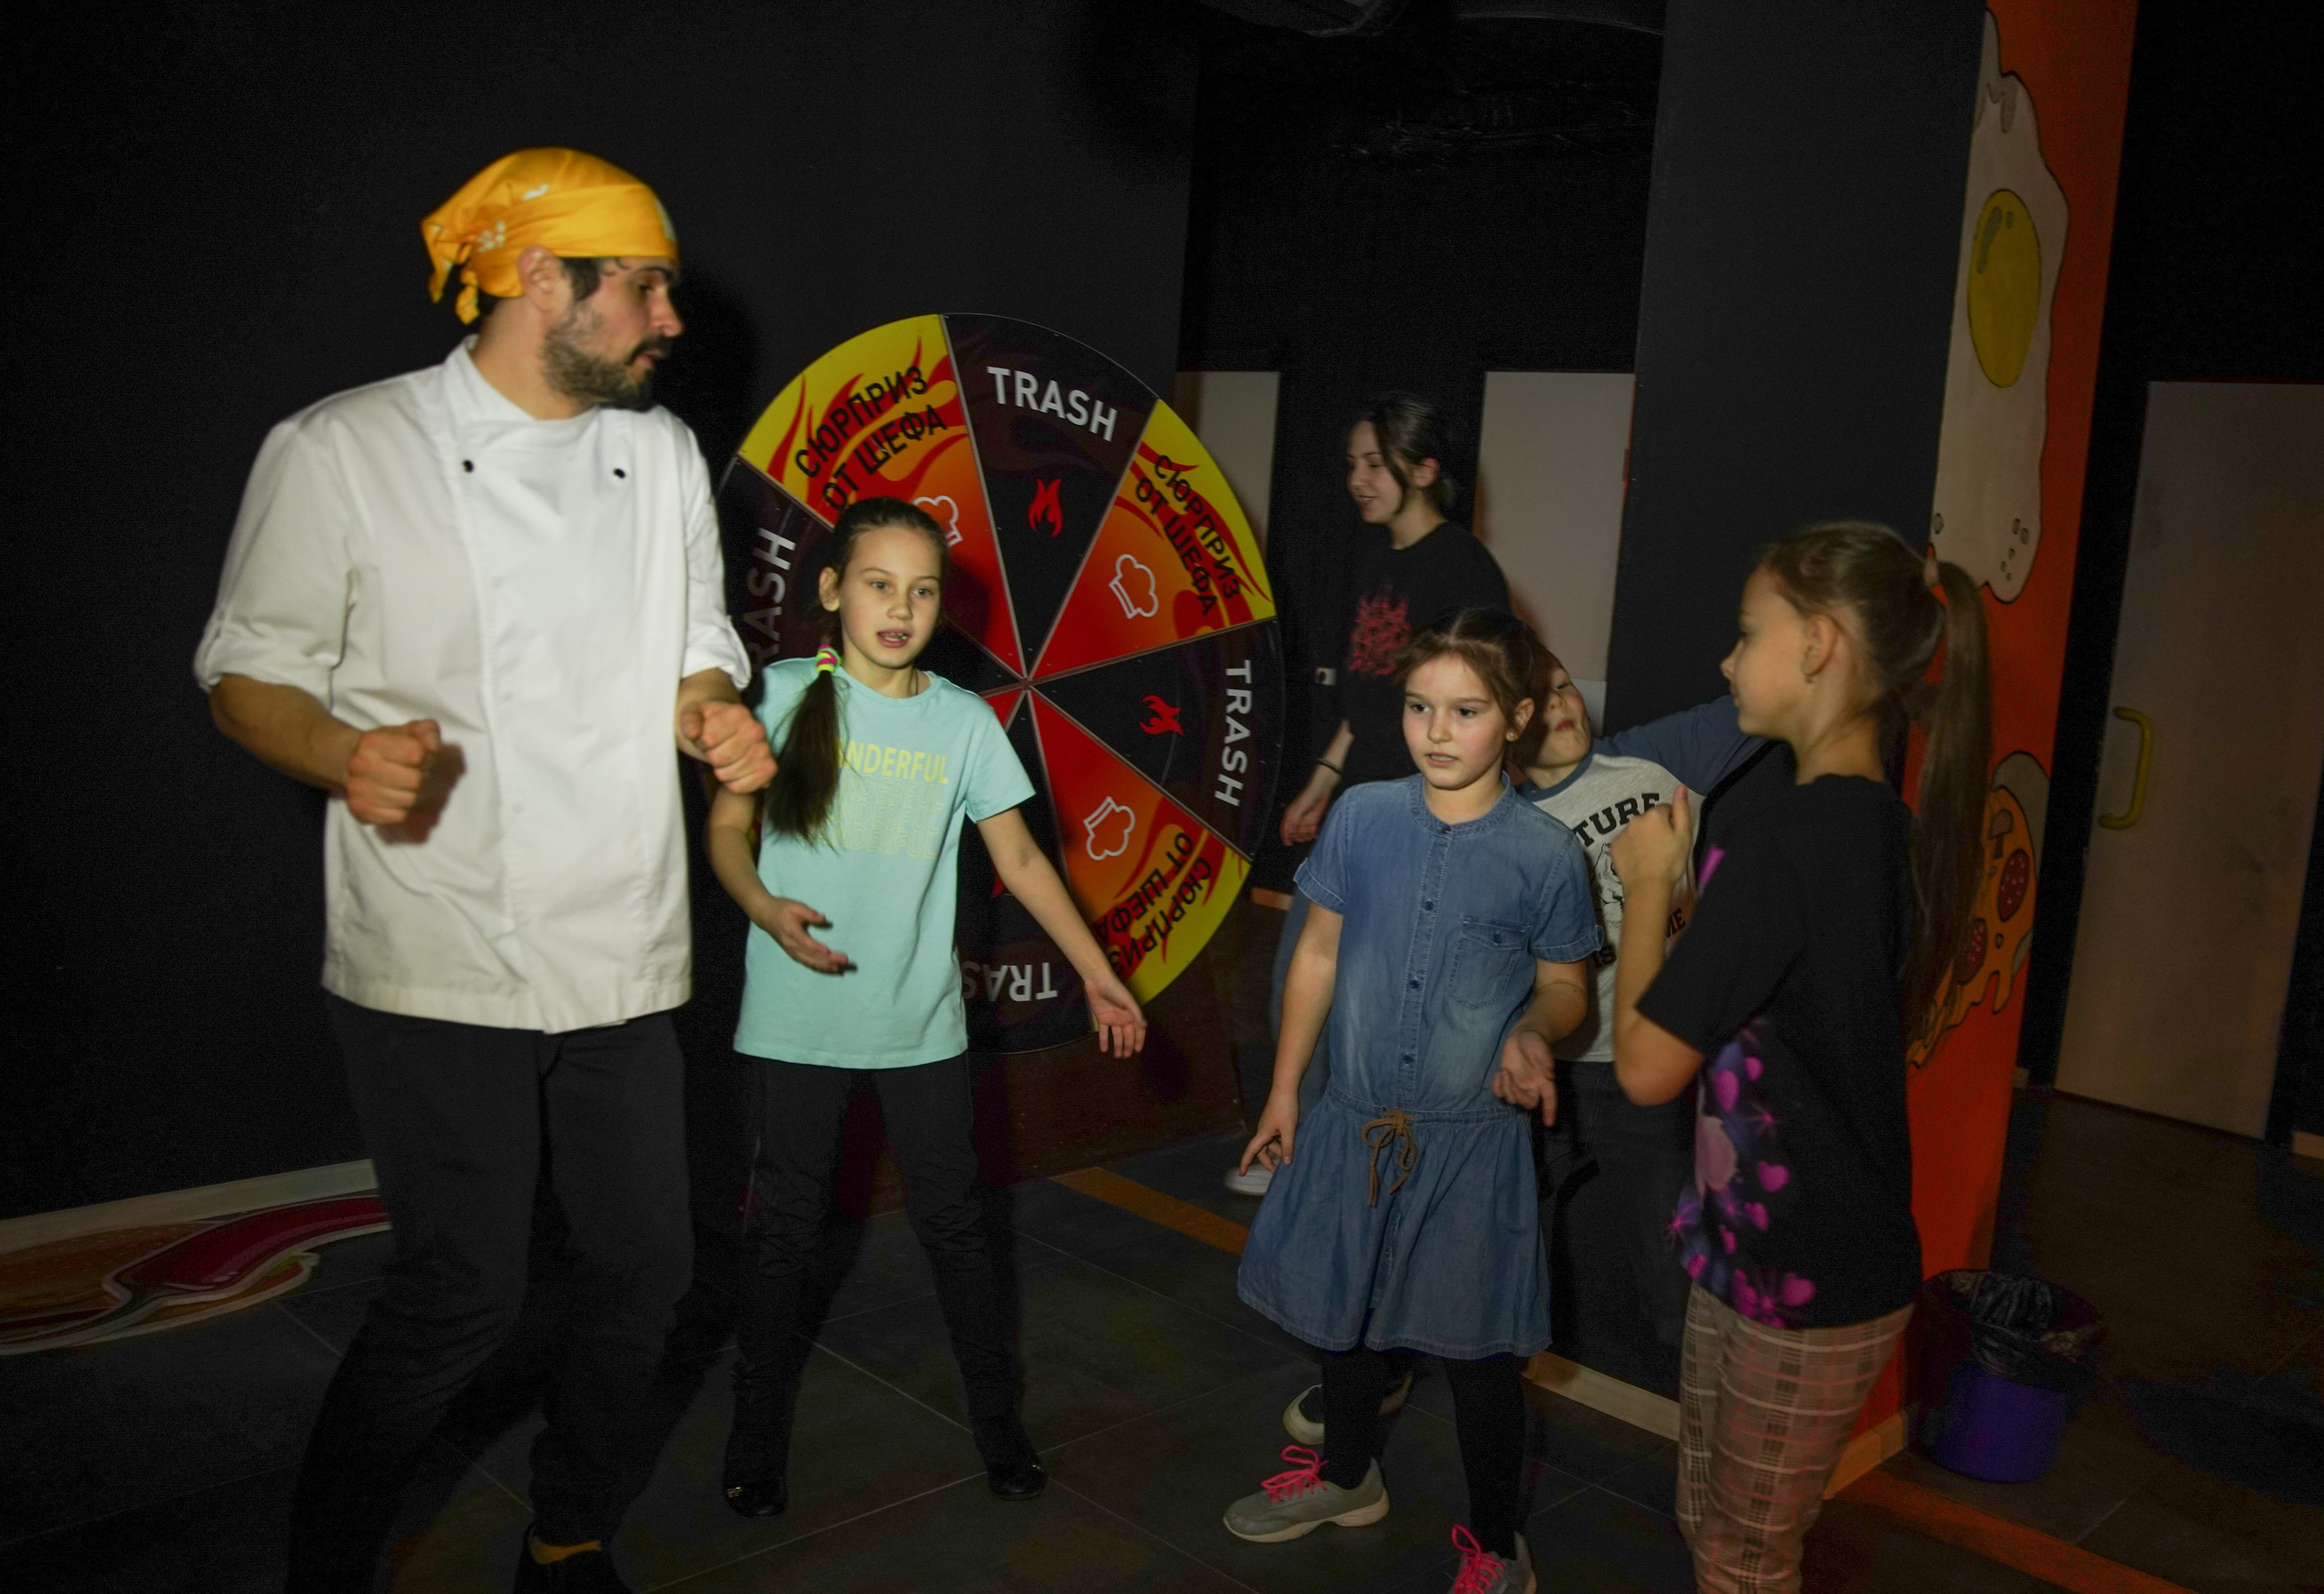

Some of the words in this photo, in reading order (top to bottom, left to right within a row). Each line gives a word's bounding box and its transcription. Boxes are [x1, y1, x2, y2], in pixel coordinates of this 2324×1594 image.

[795, 366, 927, 477] СЮРПРИЗ
[823, 463, 859, 510] ОТ
[854, 404, 947, 475] ШЕФА
[986, 366, 1118, 442] TRASH
[1137, 477, 1168, 515] ОТ
[1165, 515, 1217, 615] ШЕФА
[1156, 455, 1240, 598] СЮРПРИЗ
[1214, 659, 1253, 807] TRASH
[1166, 832, 1193, 875] ОТ
[962, 961, 1059, 1002] TRAS
